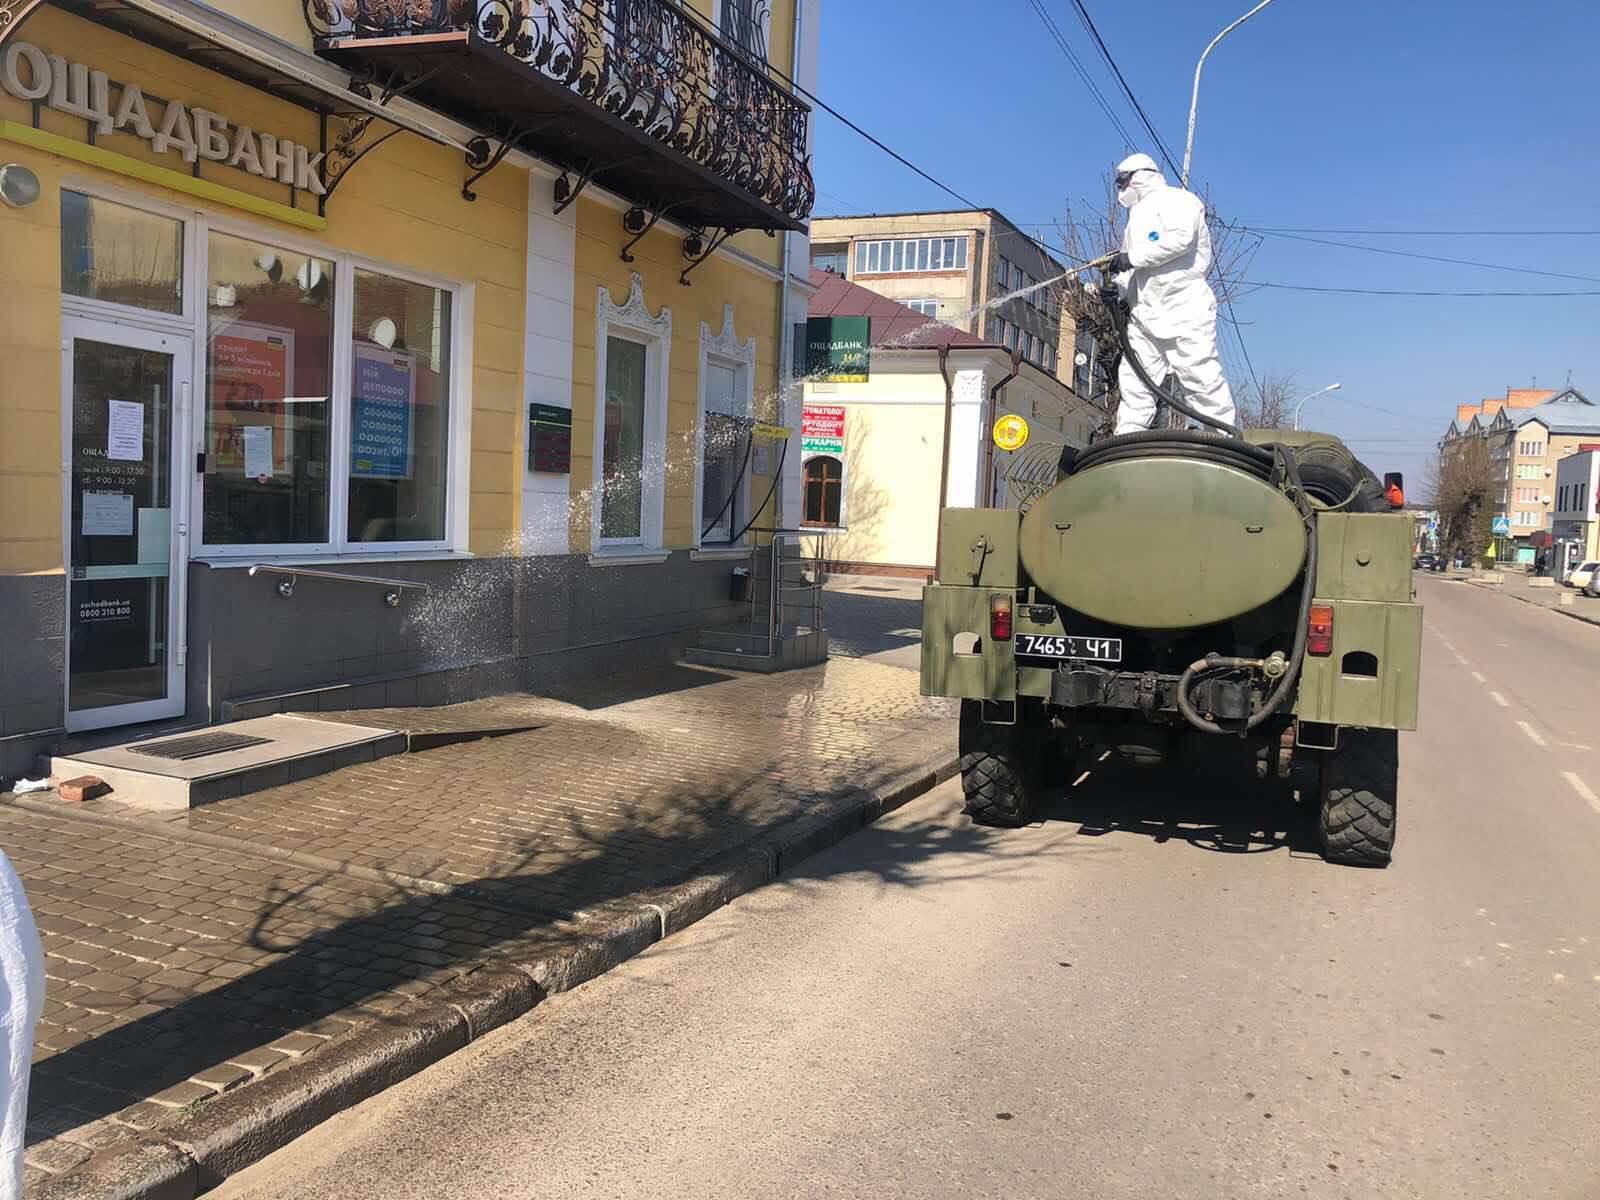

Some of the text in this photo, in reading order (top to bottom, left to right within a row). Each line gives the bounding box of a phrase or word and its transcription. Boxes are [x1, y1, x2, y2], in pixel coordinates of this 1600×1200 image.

[1, 41, 327, 195] ОЩАДБАНК
[810, 341, 862, 350] ОЩАДБАНК
[80, 608, 100, 618] 0800
[101, 608, 115, 616] 210
[1025, 636, 1065, 655] 7465
